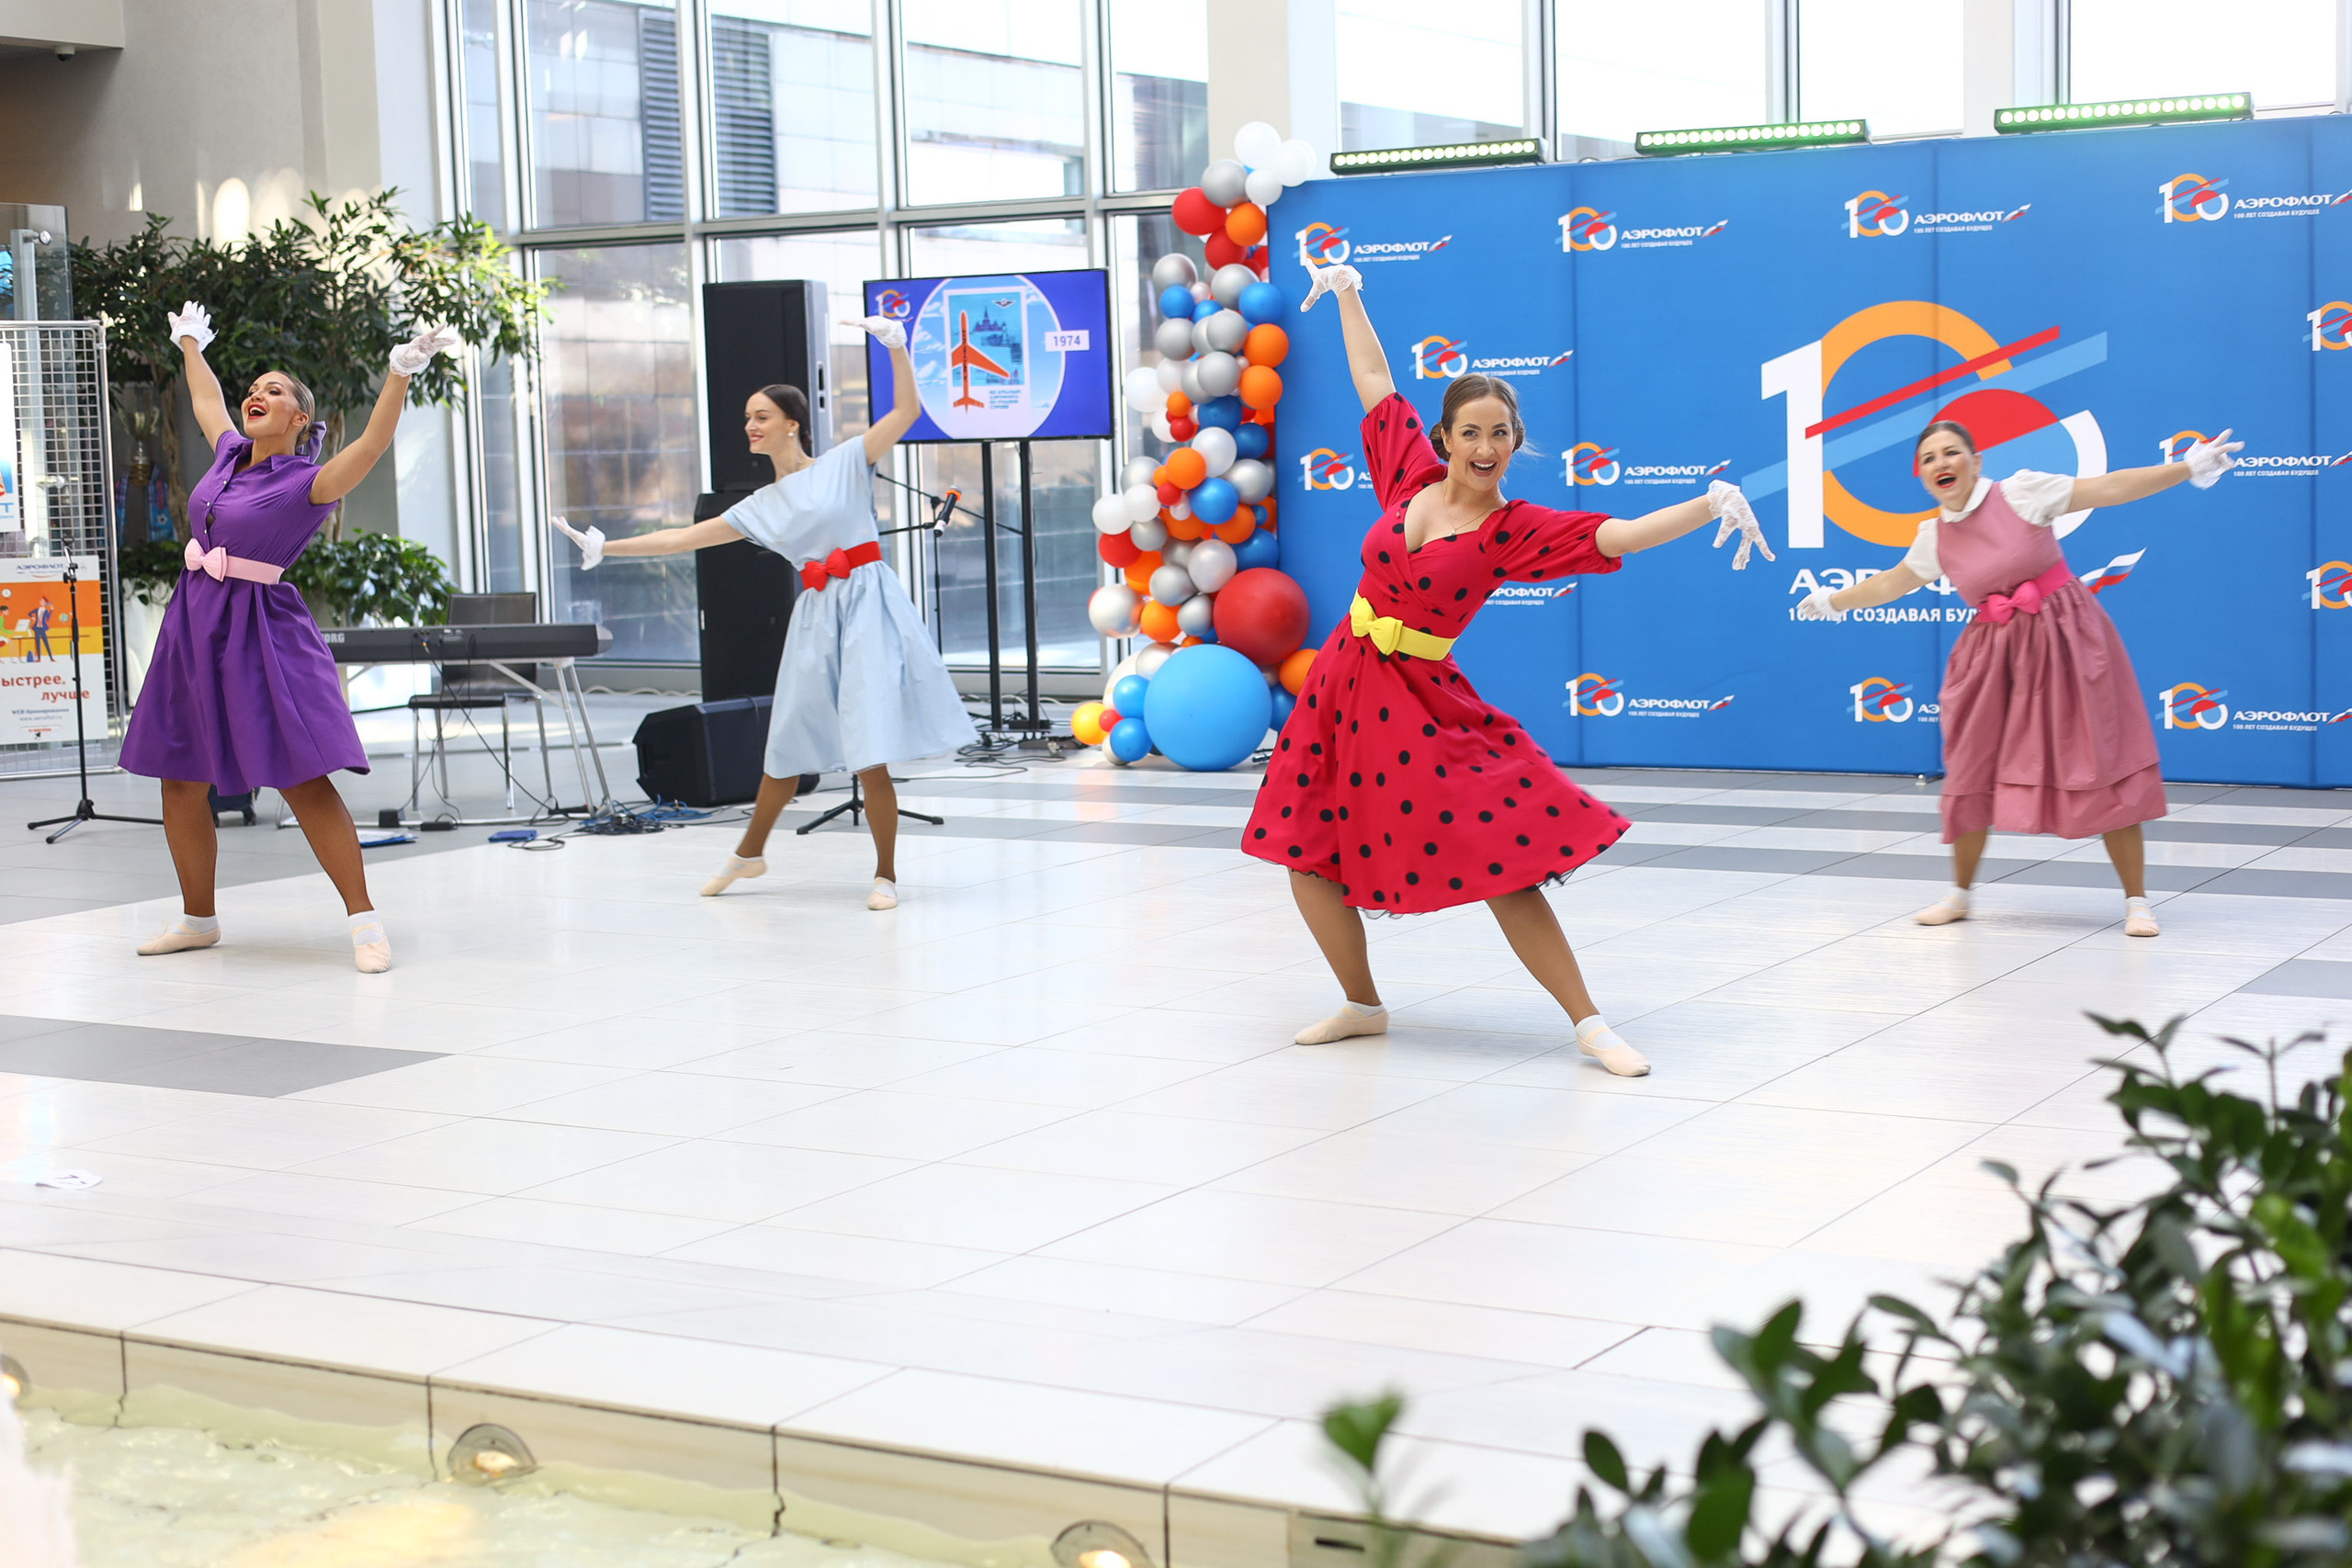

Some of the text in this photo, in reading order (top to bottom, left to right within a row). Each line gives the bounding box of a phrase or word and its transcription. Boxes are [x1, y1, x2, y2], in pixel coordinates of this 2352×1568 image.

[2233, 194, 2333, 209] АЭРОФЛОТ
[1914, 210, 2005, 225] АЭРОФЛОТ
[1621, 226, 1704, 241] АЭРОФЛОТ
[1353, 242, 1430, 254] АЭРОФЛОТ
[1053, 335, 1080, 346] 1974
[1471, 356, 1550, 368] АЭРОФЛОТ
[2233, 456, 2332, 468] АЭРОФЛОТ
[1624, 466, 1707, 476] АЭРОФЛОТ
[1489, 587, 1555, 597] РОФЛОТ
[1852, 608, 1941, 624] СОЗДАВАЯ
[322, 633, 345, 643] ORG
[1, 675, 66, 688] ыстрее.
[41, 690, 90, 703] лучше
[1628, 699, 1710, 709] АЭРОФЛОТ
[2233, 711, 2331, 722] АЭРОФЛОТ
